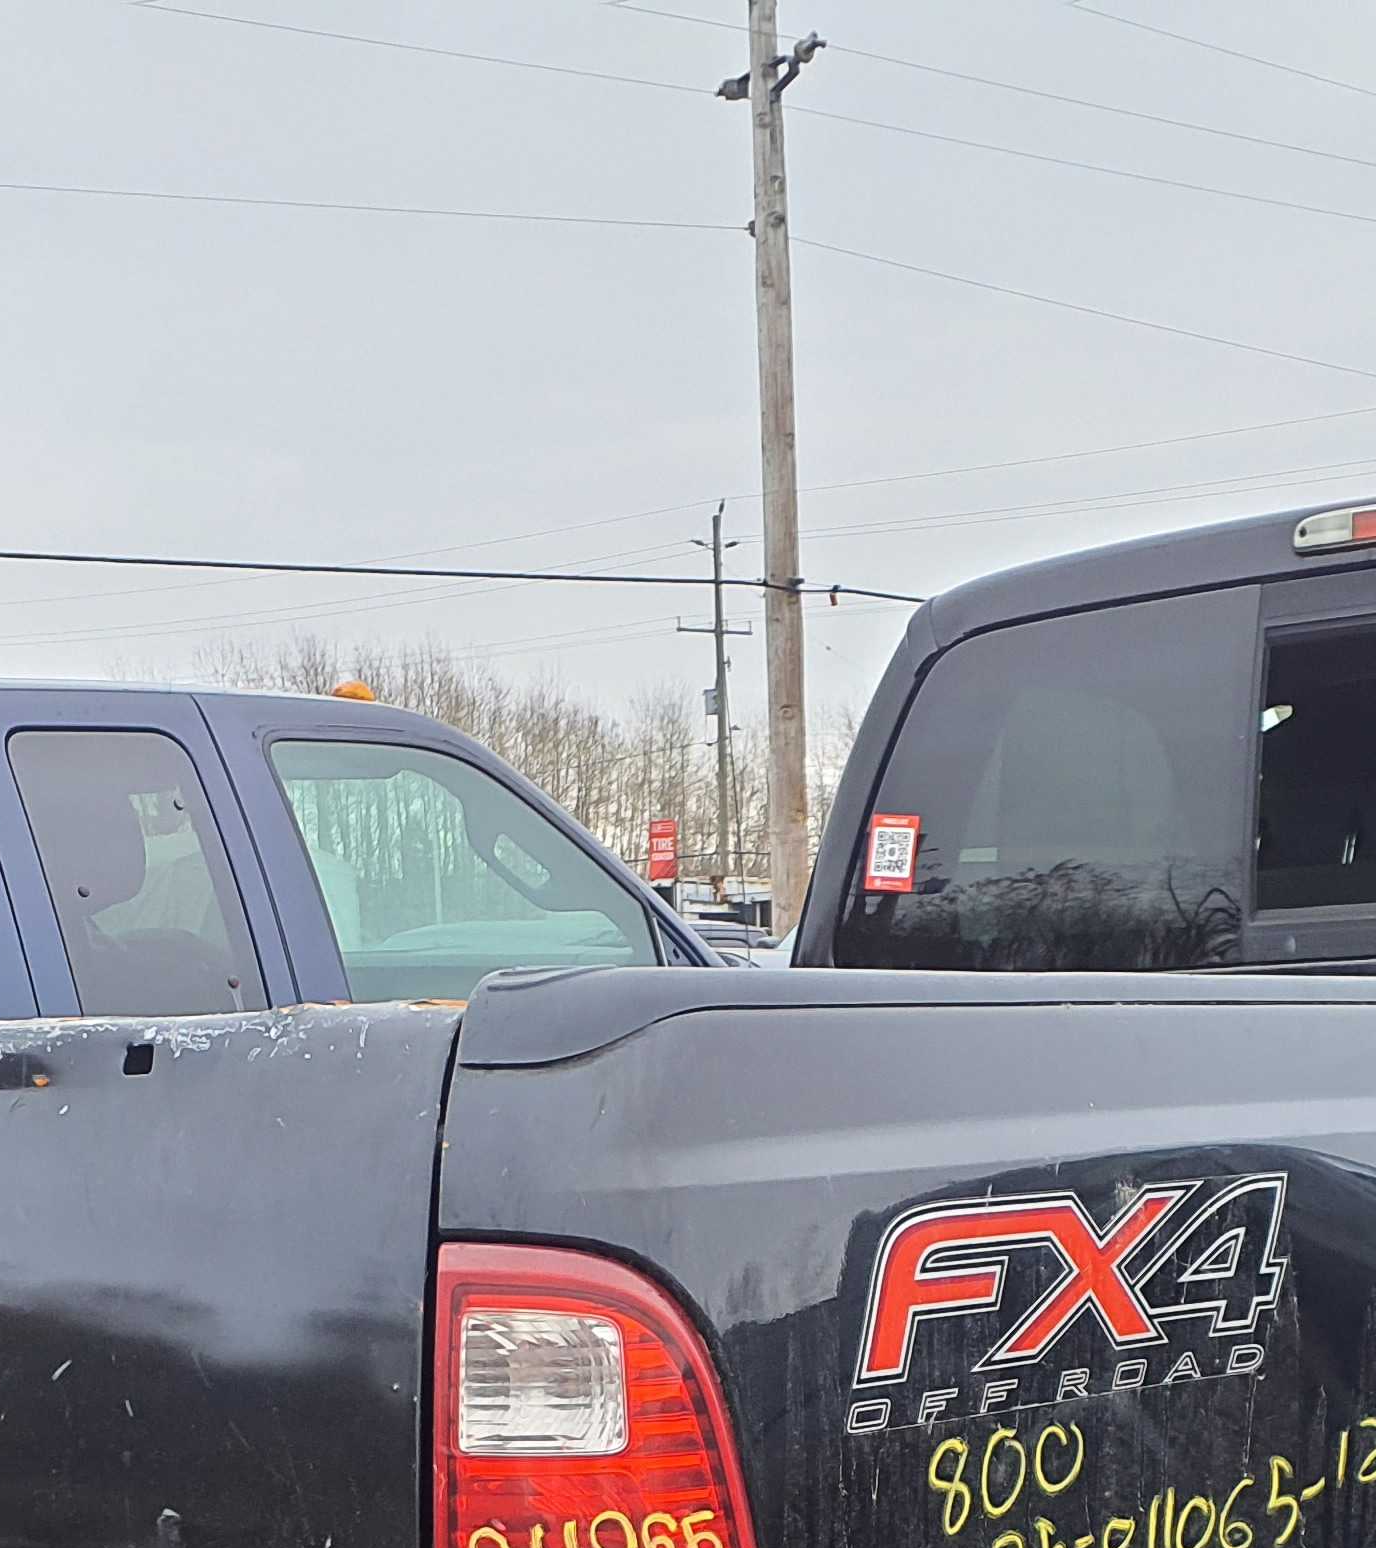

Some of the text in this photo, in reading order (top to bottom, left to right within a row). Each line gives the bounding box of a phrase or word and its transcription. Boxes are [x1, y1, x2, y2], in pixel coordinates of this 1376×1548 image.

[651, 837, 675, 851] TIRE
[850, 1172, 1288, 1392] FX4
[846, 1343, 1265, 1434] OFF ROAD
[928, 1421, 1086, 1536] 800
